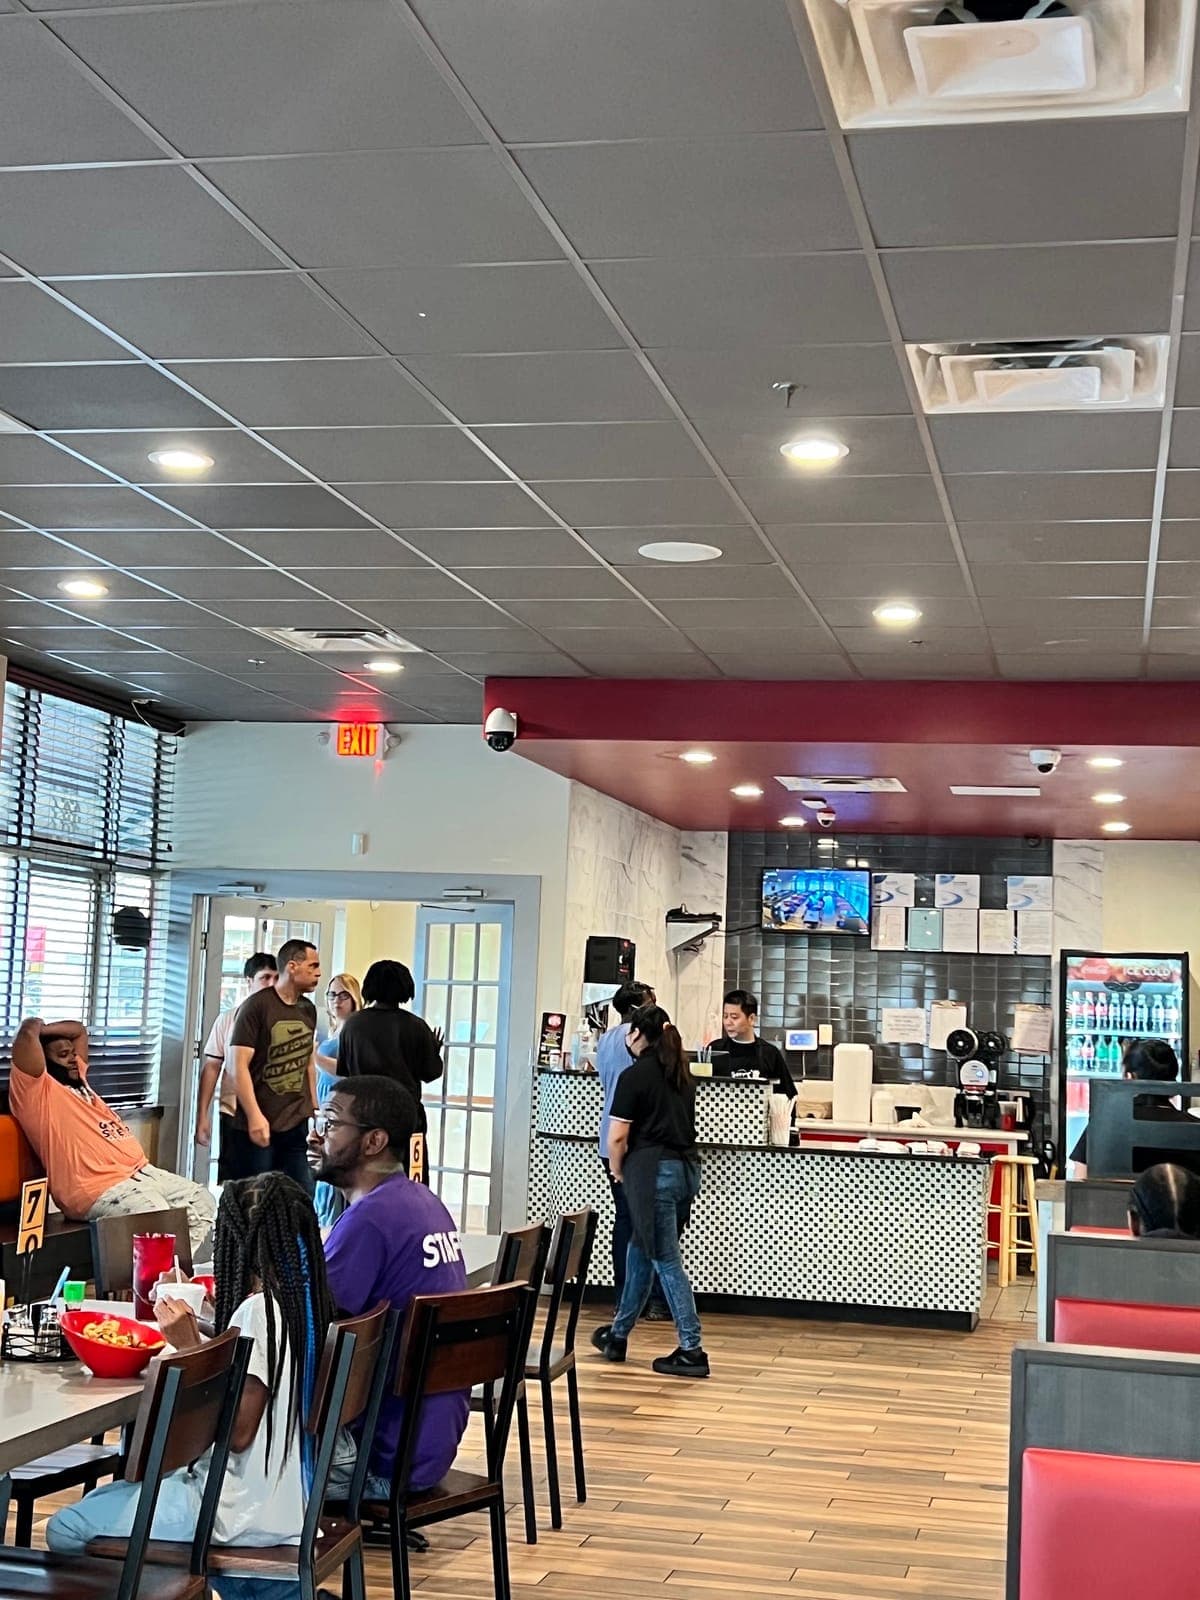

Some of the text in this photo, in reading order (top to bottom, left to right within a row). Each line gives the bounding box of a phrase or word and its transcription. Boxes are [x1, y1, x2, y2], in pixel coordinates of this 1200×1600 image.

[338, 724, 378, 755] EXIT
[1142, 966, 1171, 977] COLD
[413, 1141, 420, 1162] 6
[27, 1189, 42, 1223] 7
